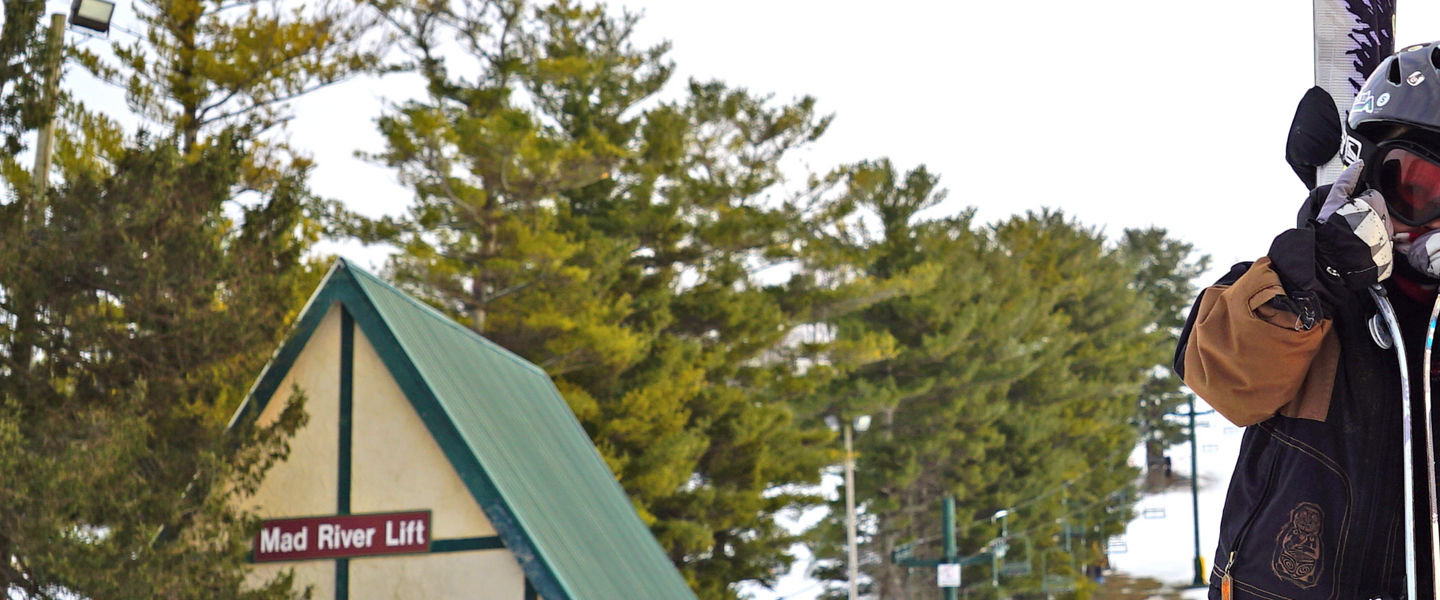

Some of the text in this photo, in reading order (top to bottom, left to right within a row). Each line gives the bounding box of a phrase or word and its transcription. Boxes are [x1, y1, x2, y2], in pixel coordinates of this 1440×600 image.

[260, 519, 425, 553] Mad River Lift
